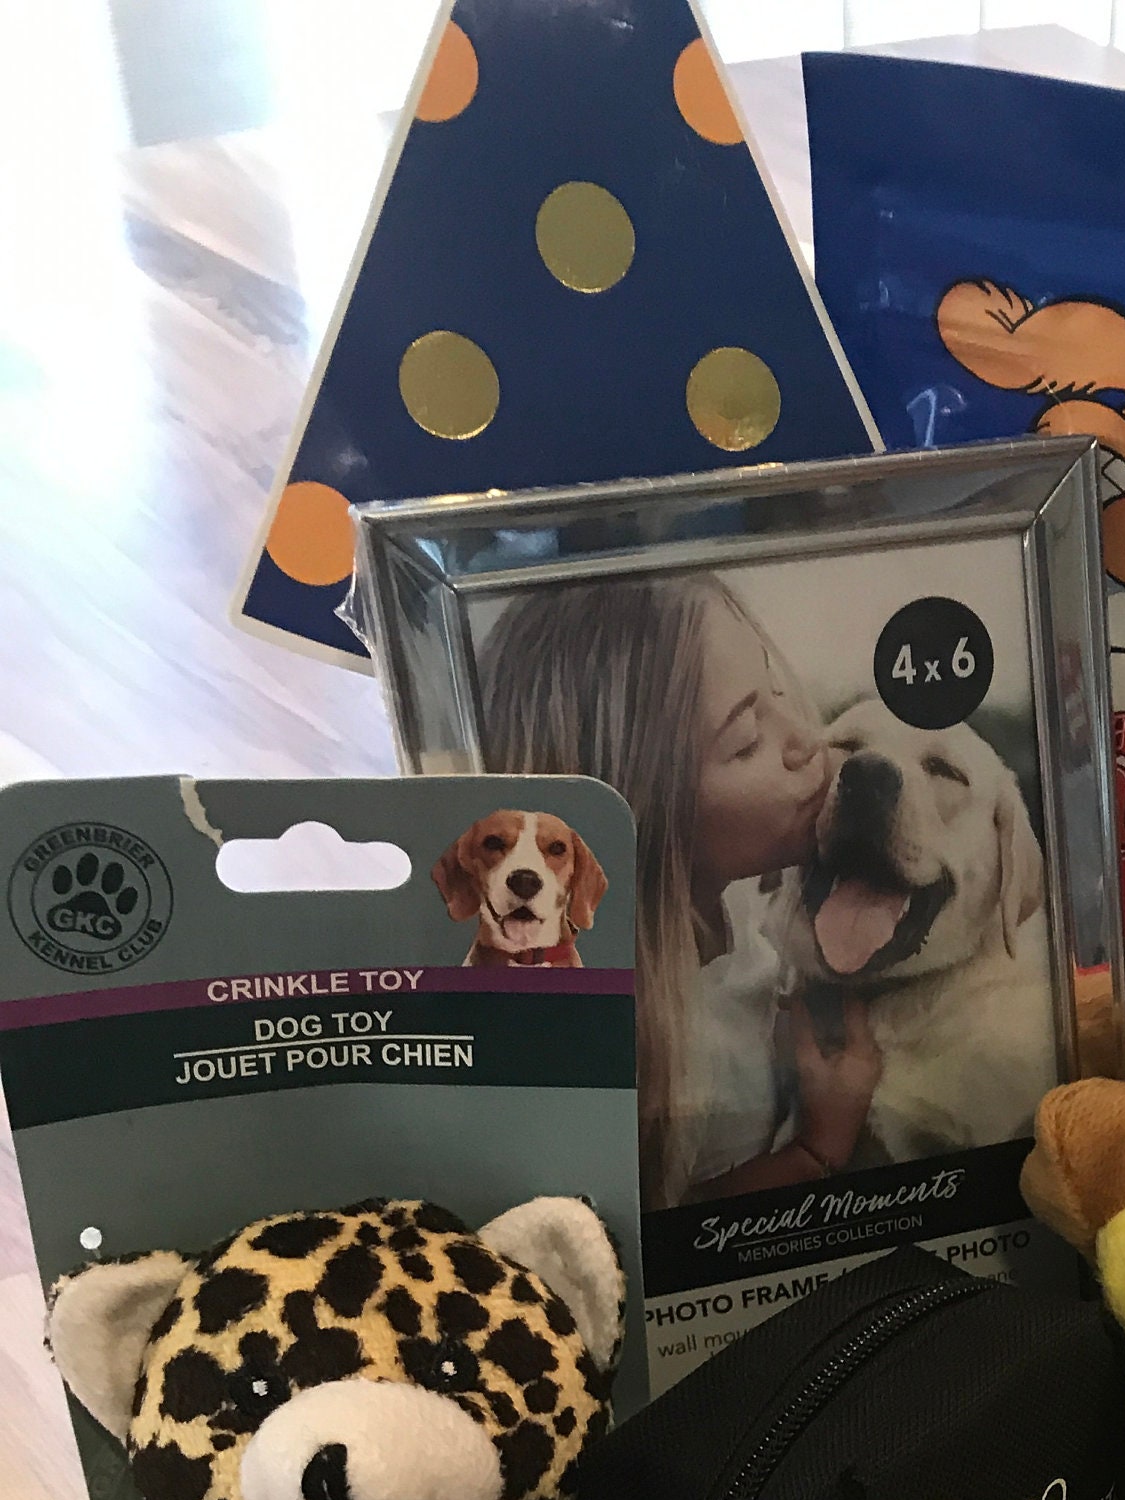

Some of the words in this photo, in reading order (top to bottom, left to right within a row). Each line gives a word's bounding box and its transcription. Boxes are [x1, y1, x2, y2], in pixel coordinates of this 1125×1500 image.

[23, 827, 157, 873] GREENBRIER
[55, 907, 116, 936] GKC
[28, 930, 113, 970] KENNEL
[117, 918, 163, 962] CLUB
[207, 971, 349, 1002] CRINKLE
[359, 969, 425, 991] TOY
[254, 1015, 323, 1042] DOG
[332, 1010, 394, 1034] TOY
[174, 1051, 278, 1085] JOUET
[286, 1043, 373, 1068] POUR
[381, 1043, 474, 1068] CHIEN
[693, 1193, 815, 1253] Special
[819, 1167, 967, 1223] Moments
[737, 1235, 822, 1264] MEMORIES
[826, 1213, 923, 1247] COLLECTION
[947, 1229, 1030, 1264] PHOTO
[658, 1334, 697, 1358] wall
